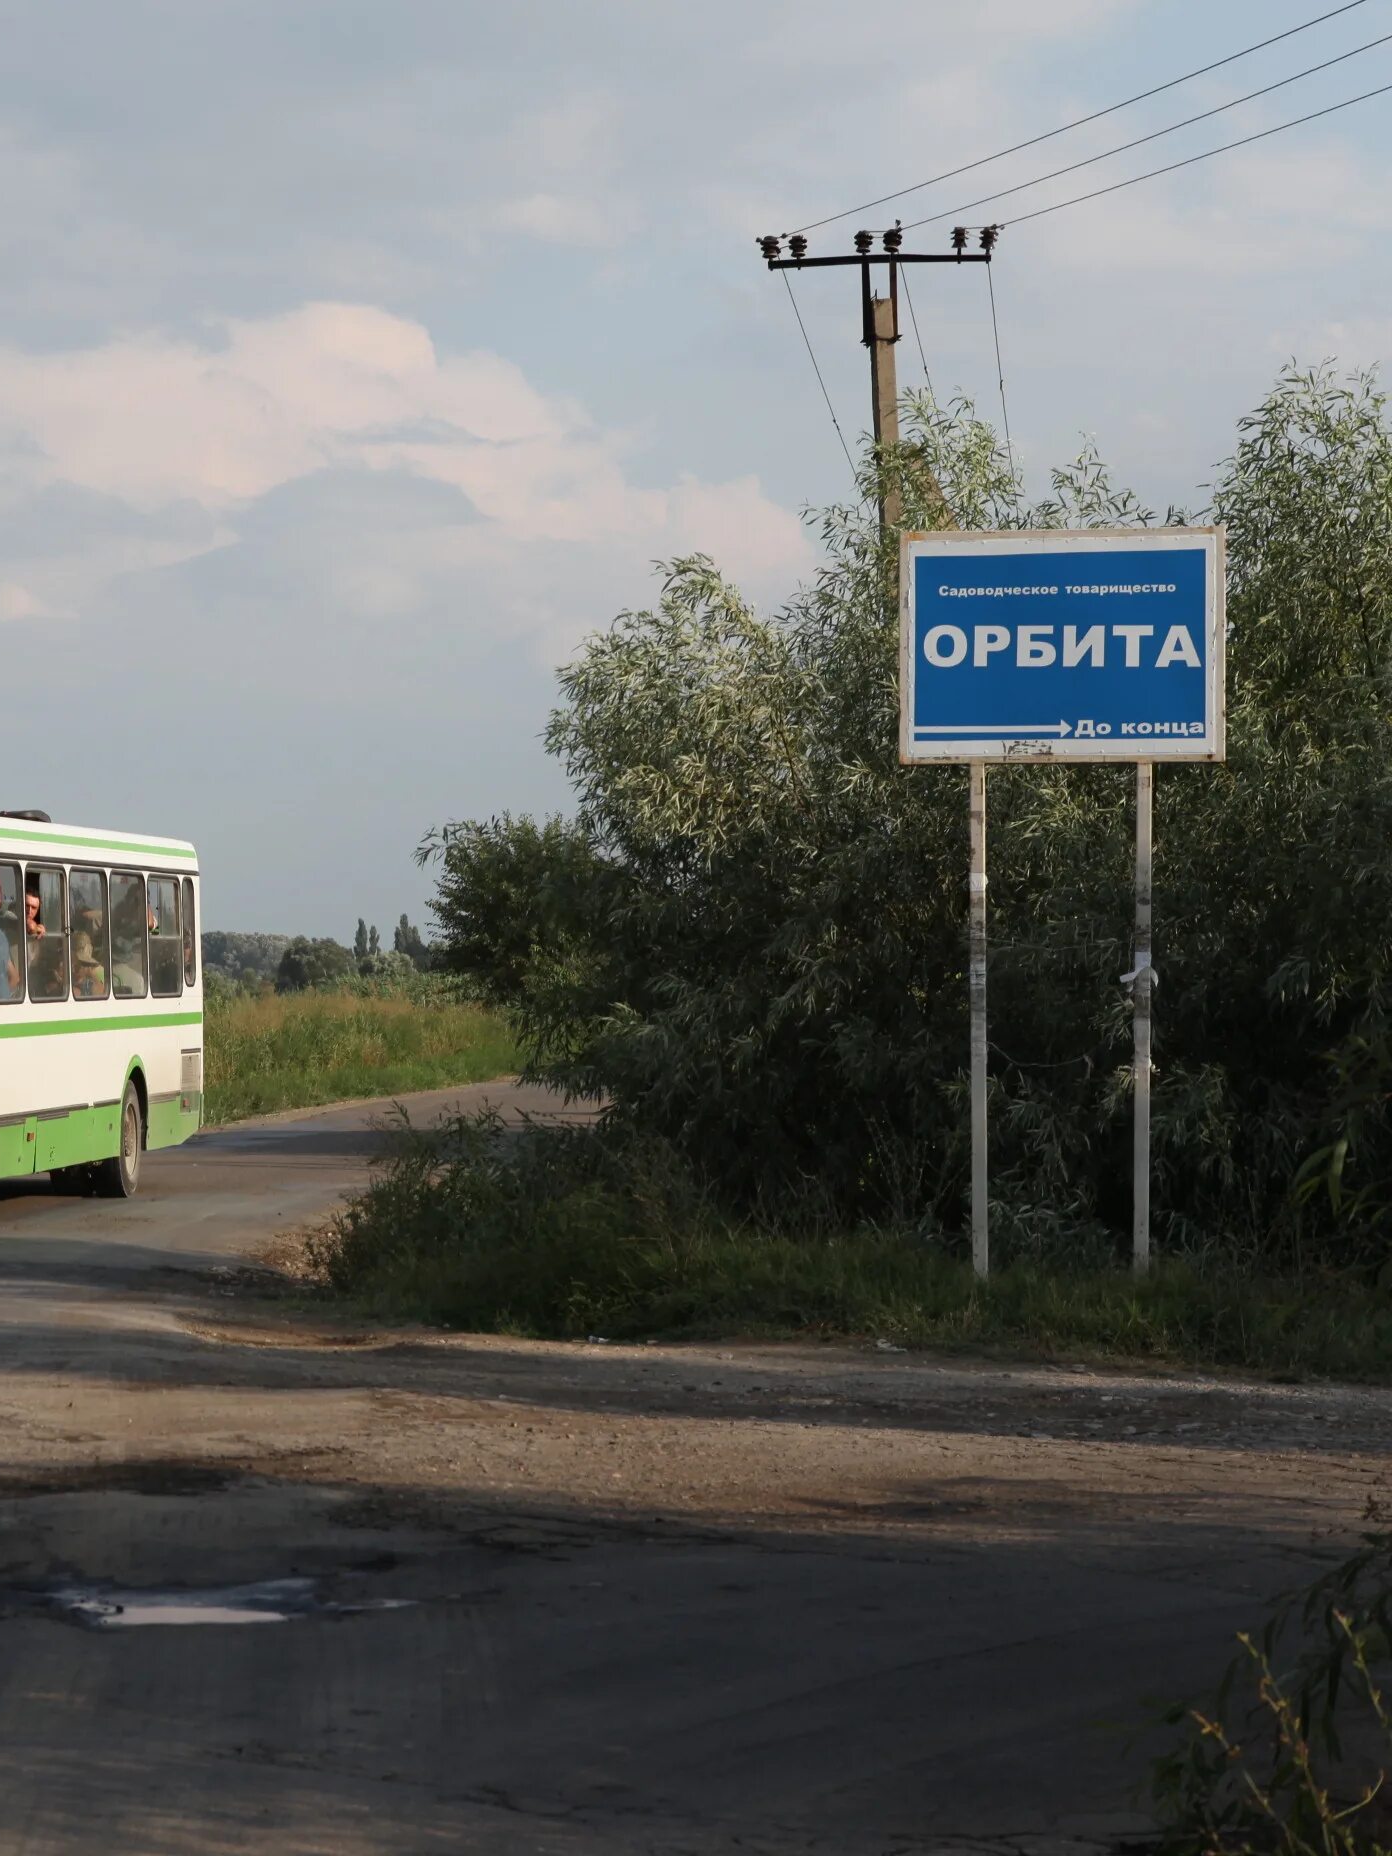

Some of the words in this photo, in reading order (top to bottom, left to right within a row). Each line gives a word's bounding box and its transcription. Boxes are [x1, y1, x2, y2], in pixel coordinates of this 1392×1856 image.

[938, 585, 1058, 598] Садоводческое
[1065, 582, 1176, 595] товарищество
[923, 624, 1201, 668] ОРБИТА
[1074, 719, 1111, 738] До
[1121, 722, 1204, 736] конца
